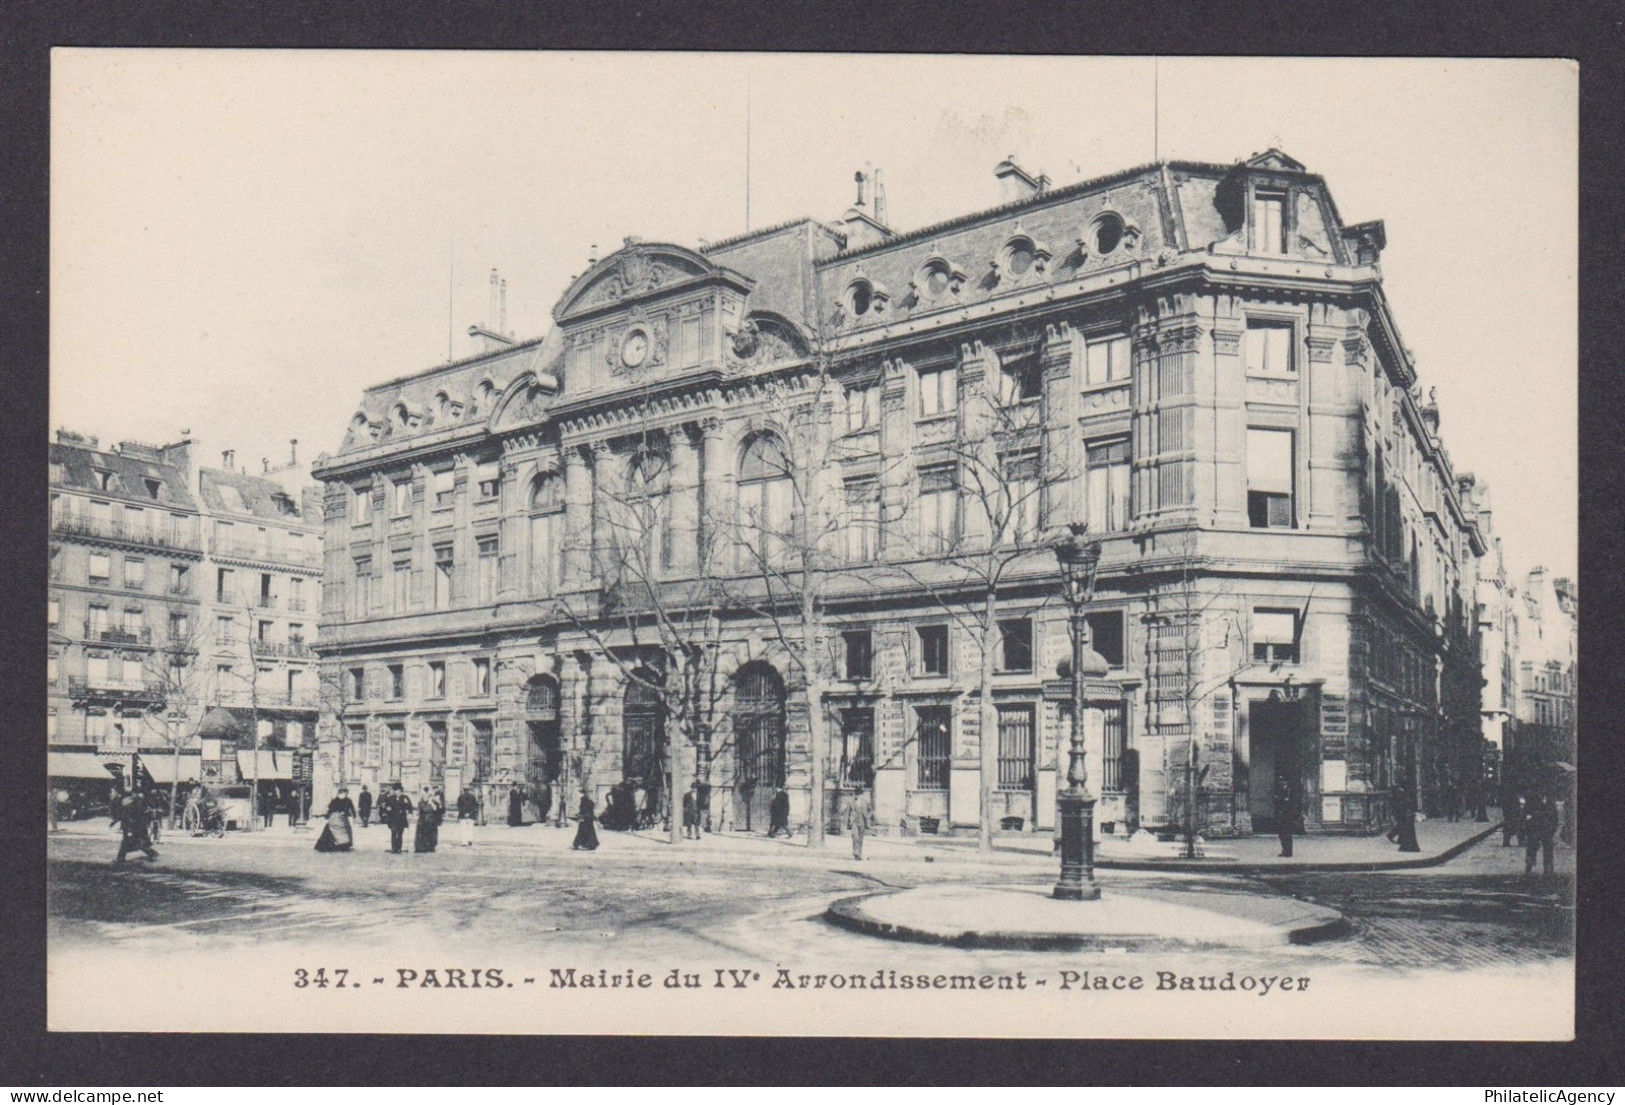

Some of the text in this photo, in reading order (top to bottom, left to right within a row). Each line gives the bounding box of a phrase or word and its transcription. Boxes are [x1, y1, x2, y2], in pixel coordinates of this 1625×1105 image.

[293, 967, 361, 989] 347.
[396, 968, 514, 989] PARIS.
[549, 968, 653, 989] Mairie
[663, 968, 702, 989] du
[772, 968, 1027, 990] Arrondissement
[1059, 969, 1144, 991] Place
[1155, 970, 1311, 996] Baudoyer
